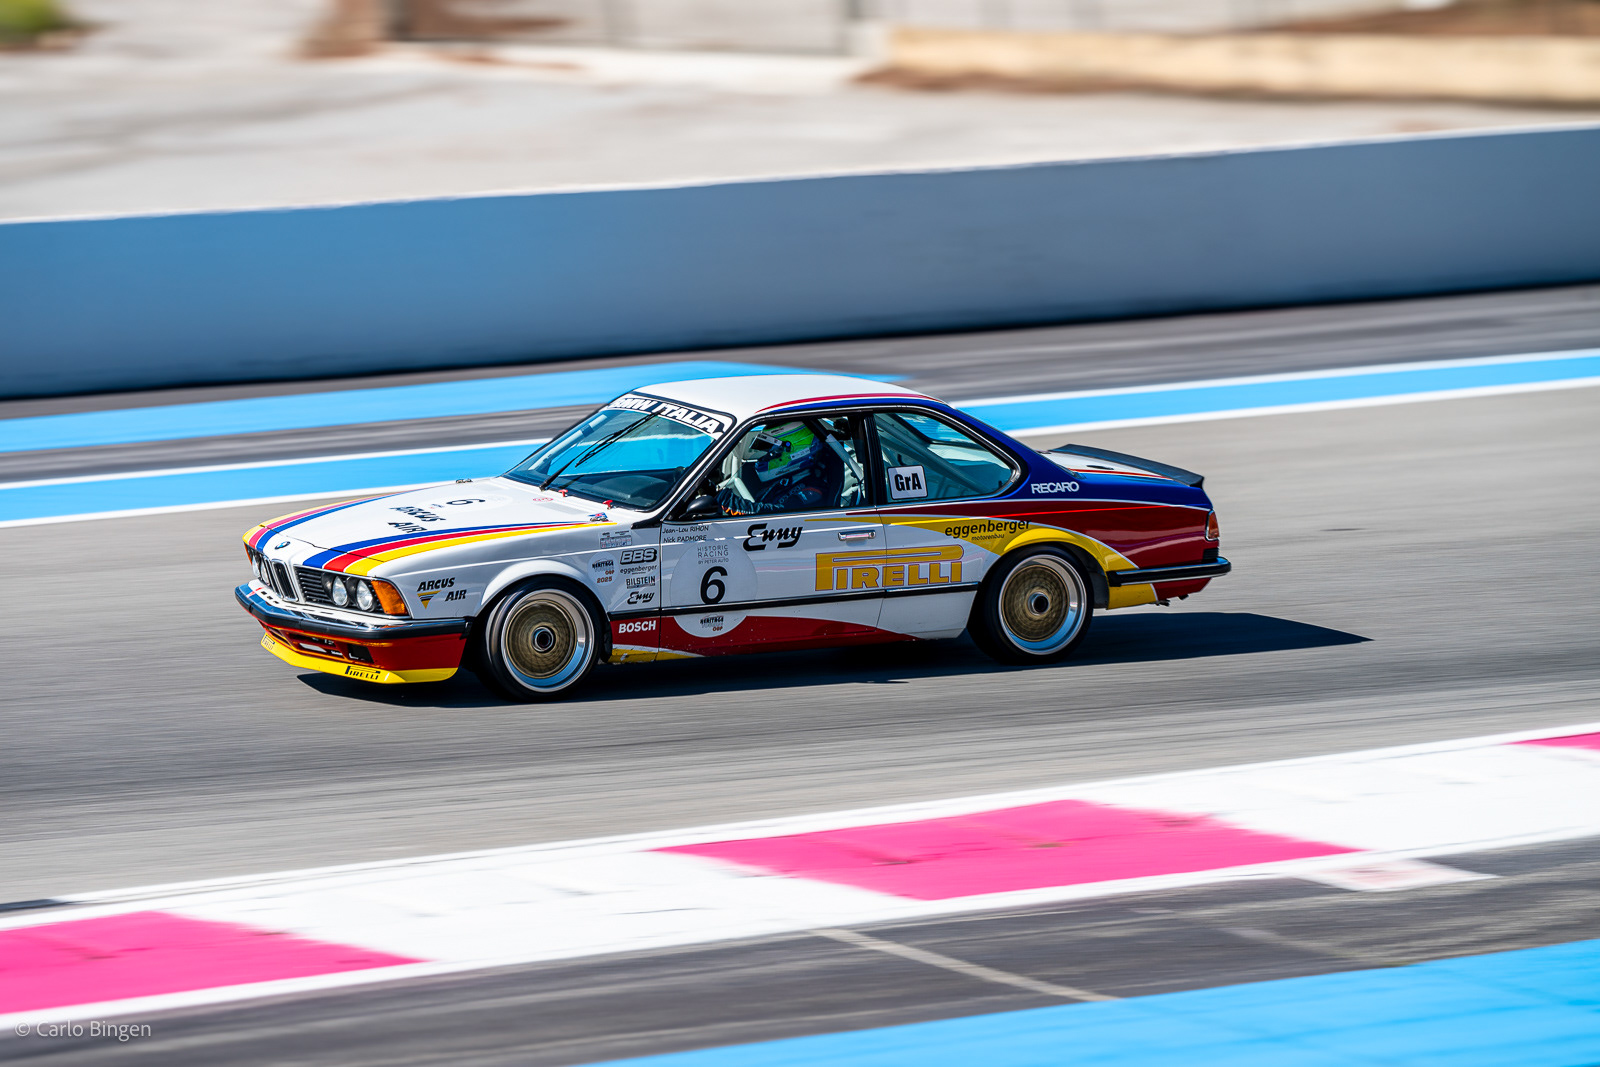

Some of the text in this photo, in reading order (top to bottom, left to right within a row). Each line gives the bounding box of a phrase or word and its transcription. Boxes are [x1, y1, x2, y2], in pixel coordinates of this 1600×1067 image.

[652, 403, 721, 434] ITALIA
[894, 473, 922, 491] GrA
[1031, 481, 1080, 494] RECARO
[944, 519, 1032, 539] eggenberger
[971, 533, 1005, 541] motorenbau
[620, 548, 657, 565] BBS
[697, 550, 729, 558] RACING
[620, 564, 657, 575] eggenberger
[815, 544, 964, 591] PIRELLI
[417, 577, 455, 592] ARCUS
[626, 576, 656, 586] BILSTEIN
[700, 566, 728, 605] 6
[445, 589, 467, 601] AIR
[618, 620, 657, 633] BOSCH
[344, 665, 381, 680] PIRELLI
